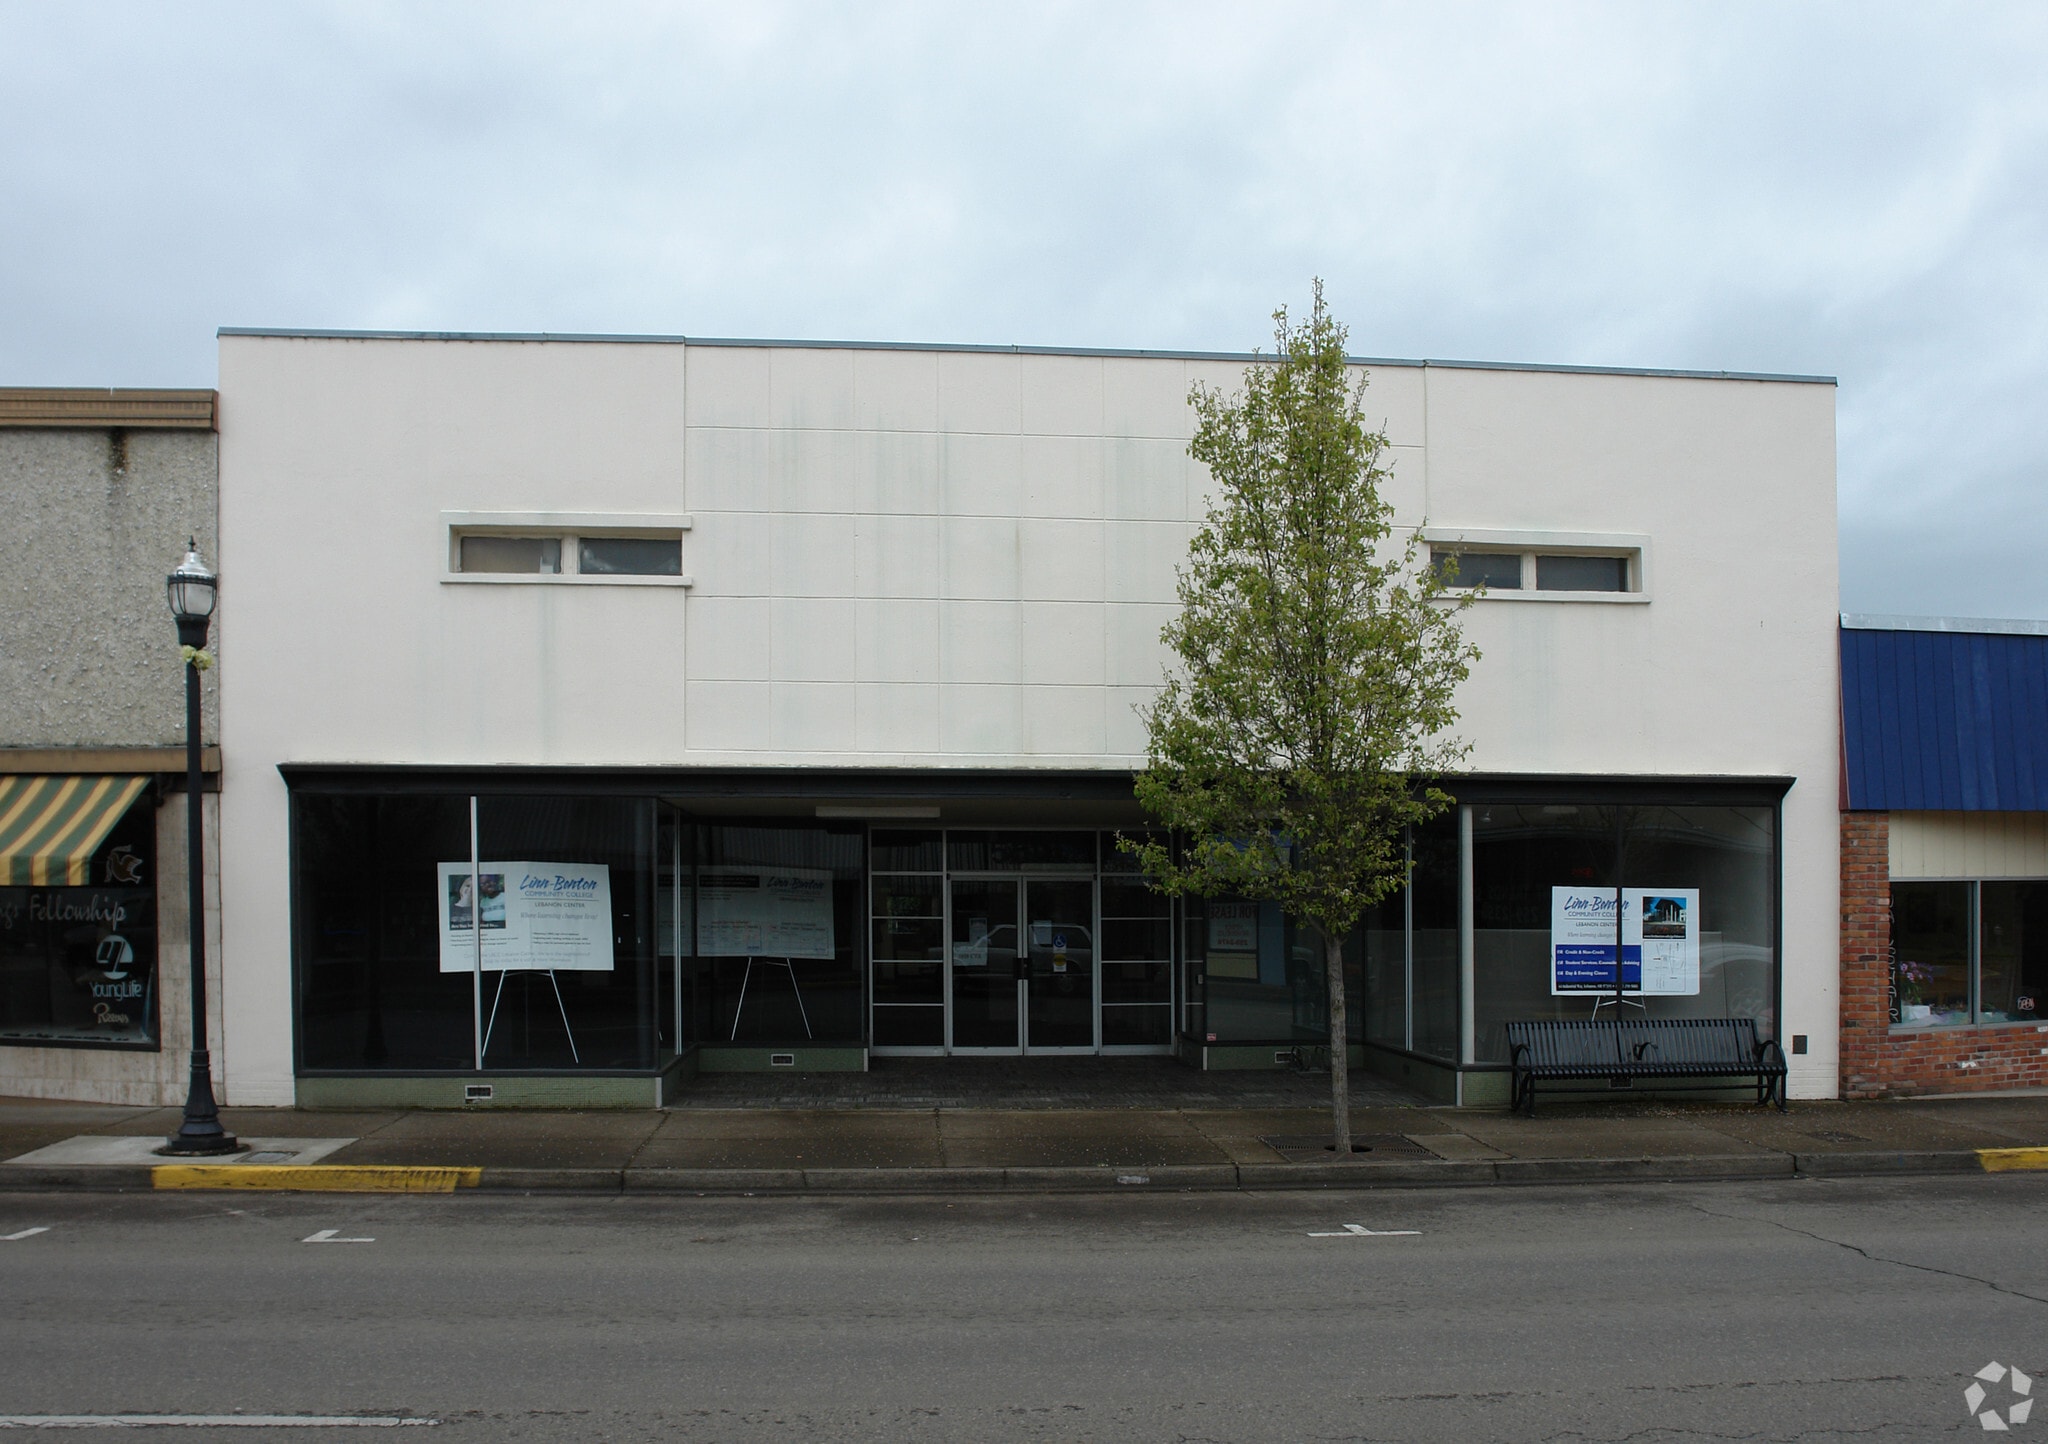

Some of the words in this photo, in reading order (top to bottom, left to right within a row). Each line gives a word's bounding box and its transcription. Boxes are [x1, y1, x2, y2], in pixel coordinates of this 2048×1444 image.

[520, 874, 598, 891] Linn-Benton
[1564, 896, 1629, 911] Linn-Bentn
[29, 893, 127, 932] Fellowship
